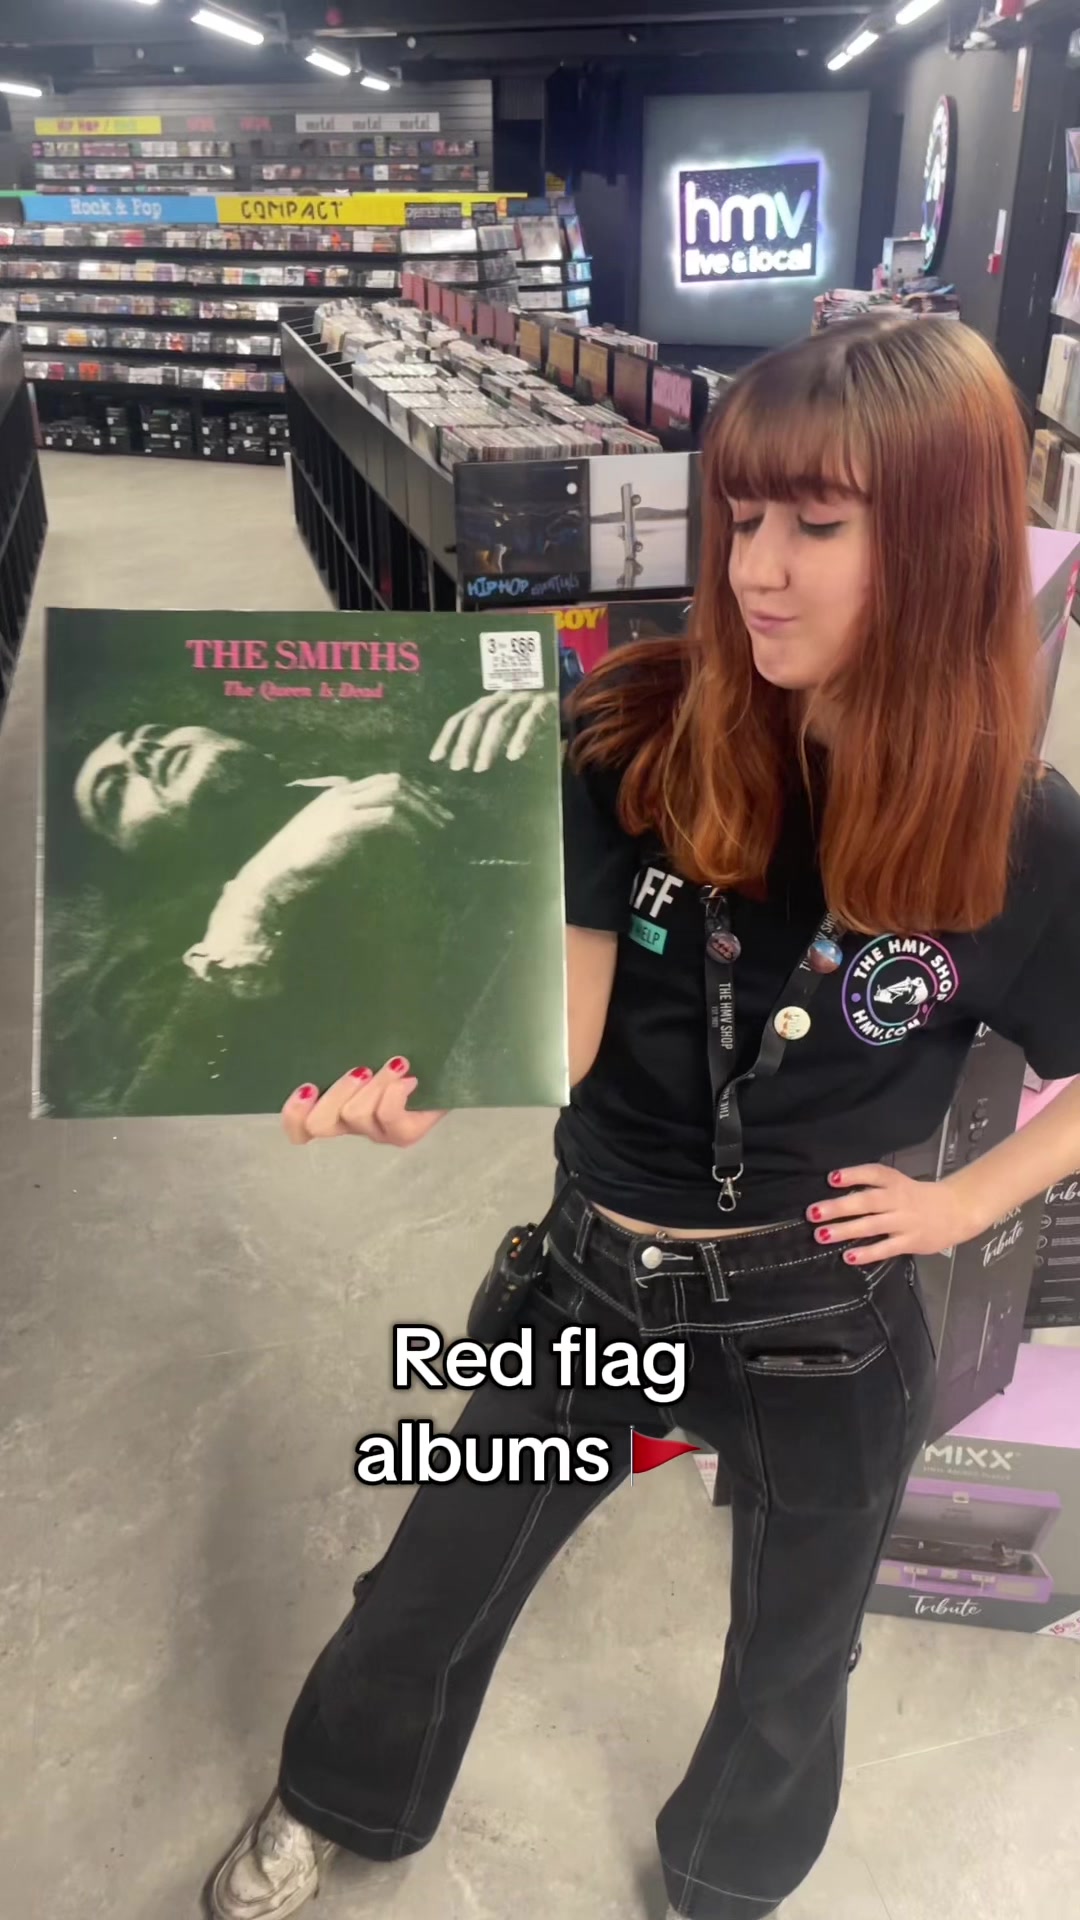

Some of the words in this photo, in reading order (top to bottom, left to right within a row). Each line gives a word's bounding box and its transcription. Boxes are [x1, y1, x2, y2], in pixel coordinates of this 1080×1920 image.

[70, 197, 113, 216] Rock
[114, 198, 129, 215] &
[131, 197, 163, 219] Pop
[240, 200, 344, 221] COMPACT
[684, 180, 812, 244] hmv
[185, 638, 269, 670] THE
[274, 639, 421, 672] SMITHS
[223, 680, 255, 698] The
[259, 680, 313, 702] Queen
[318, 681, 335, 699] Is
[338, 681, 385, 699] Dead
[820, 912, 837, 934] SHO
[853, 946, 885, 979] THE
[887, 938, 932, 957] HMV
[718, 982, 733, 1001] THE
[719, 1002, 733, 1024] HMV
[720, 1024, 734, 1051] SHOP
[980, 1220, 1025, 1268] Tribute
[924, 1443, 1014, 1472] MIXX
[907, 1593, 983, 1618] Tribute
